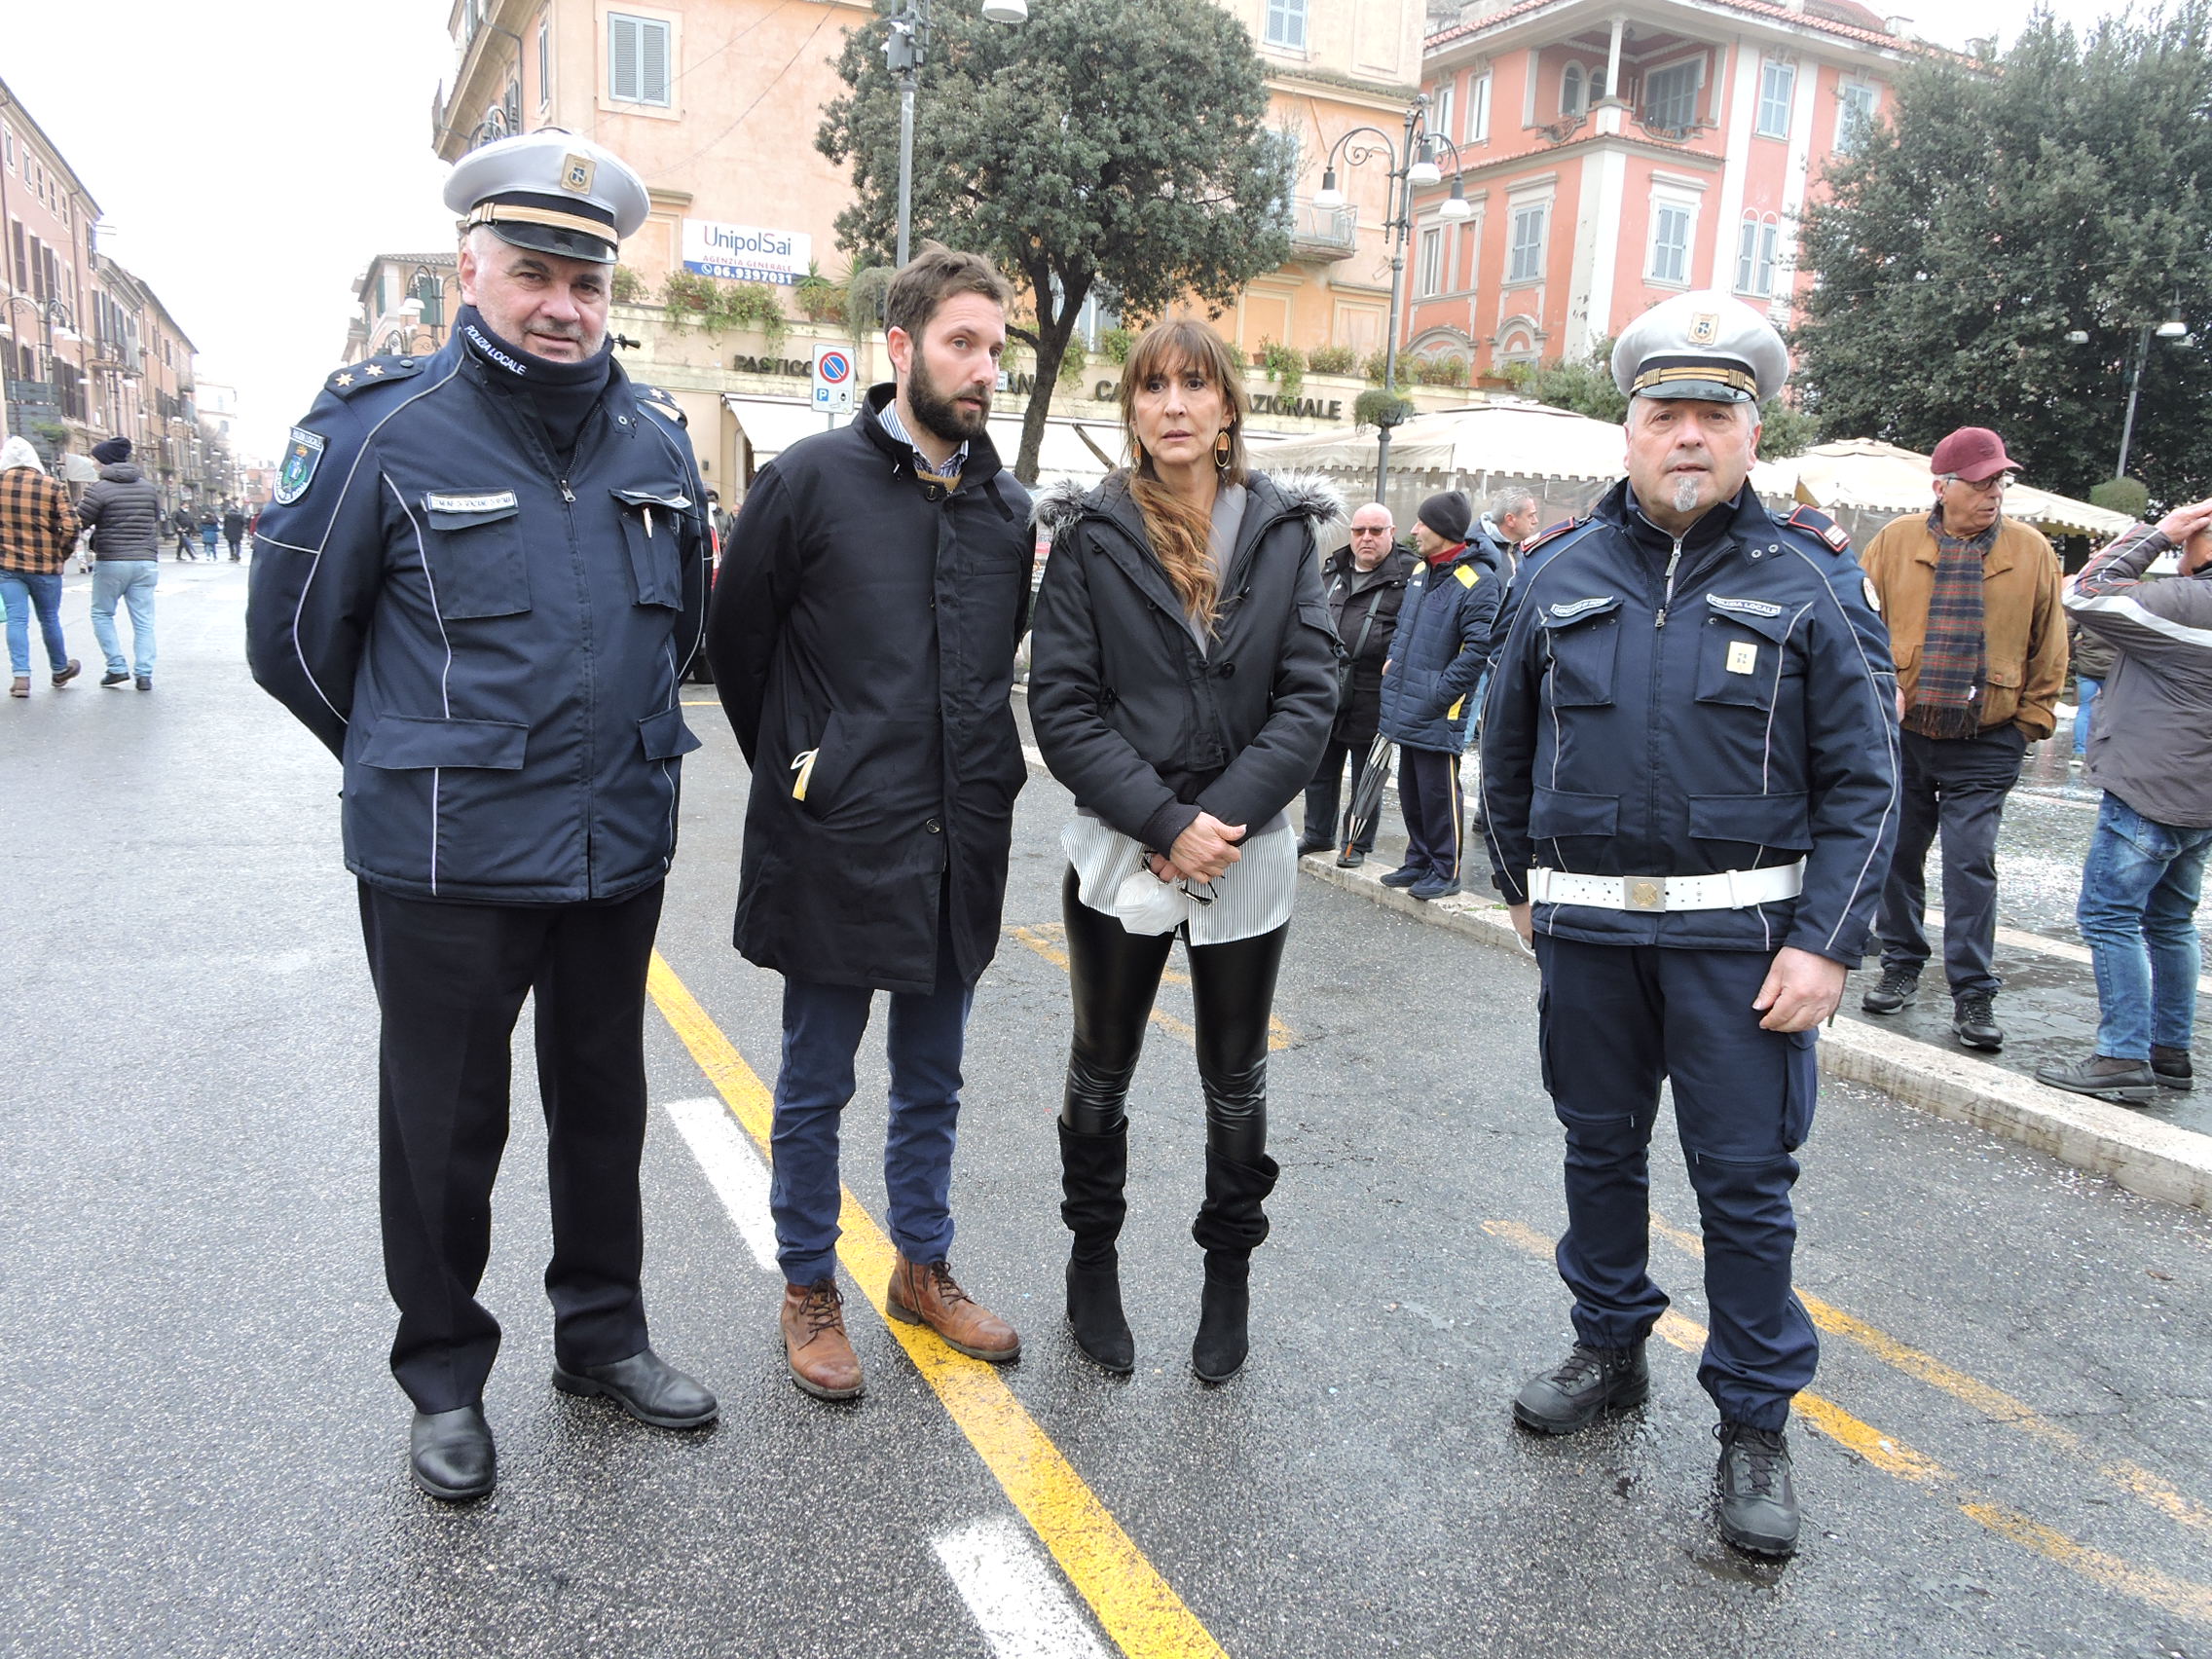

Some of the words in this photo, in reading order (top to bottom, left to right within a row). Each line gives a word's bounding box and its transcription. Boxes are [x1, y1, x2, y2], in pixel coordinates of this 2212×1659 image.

[704, 225, 792, 256] UnipolSai
[702, 255, 744, 267] AGENZIA
[747, 260, 793, 272] GENERALE
[713, 265, 793, 284] 06.9397031
[463, 324, 492, 351] POLIZIA
[487, 348, 527, 376] LOCALE
[1744, 602, 1778, 614] LOCALE
